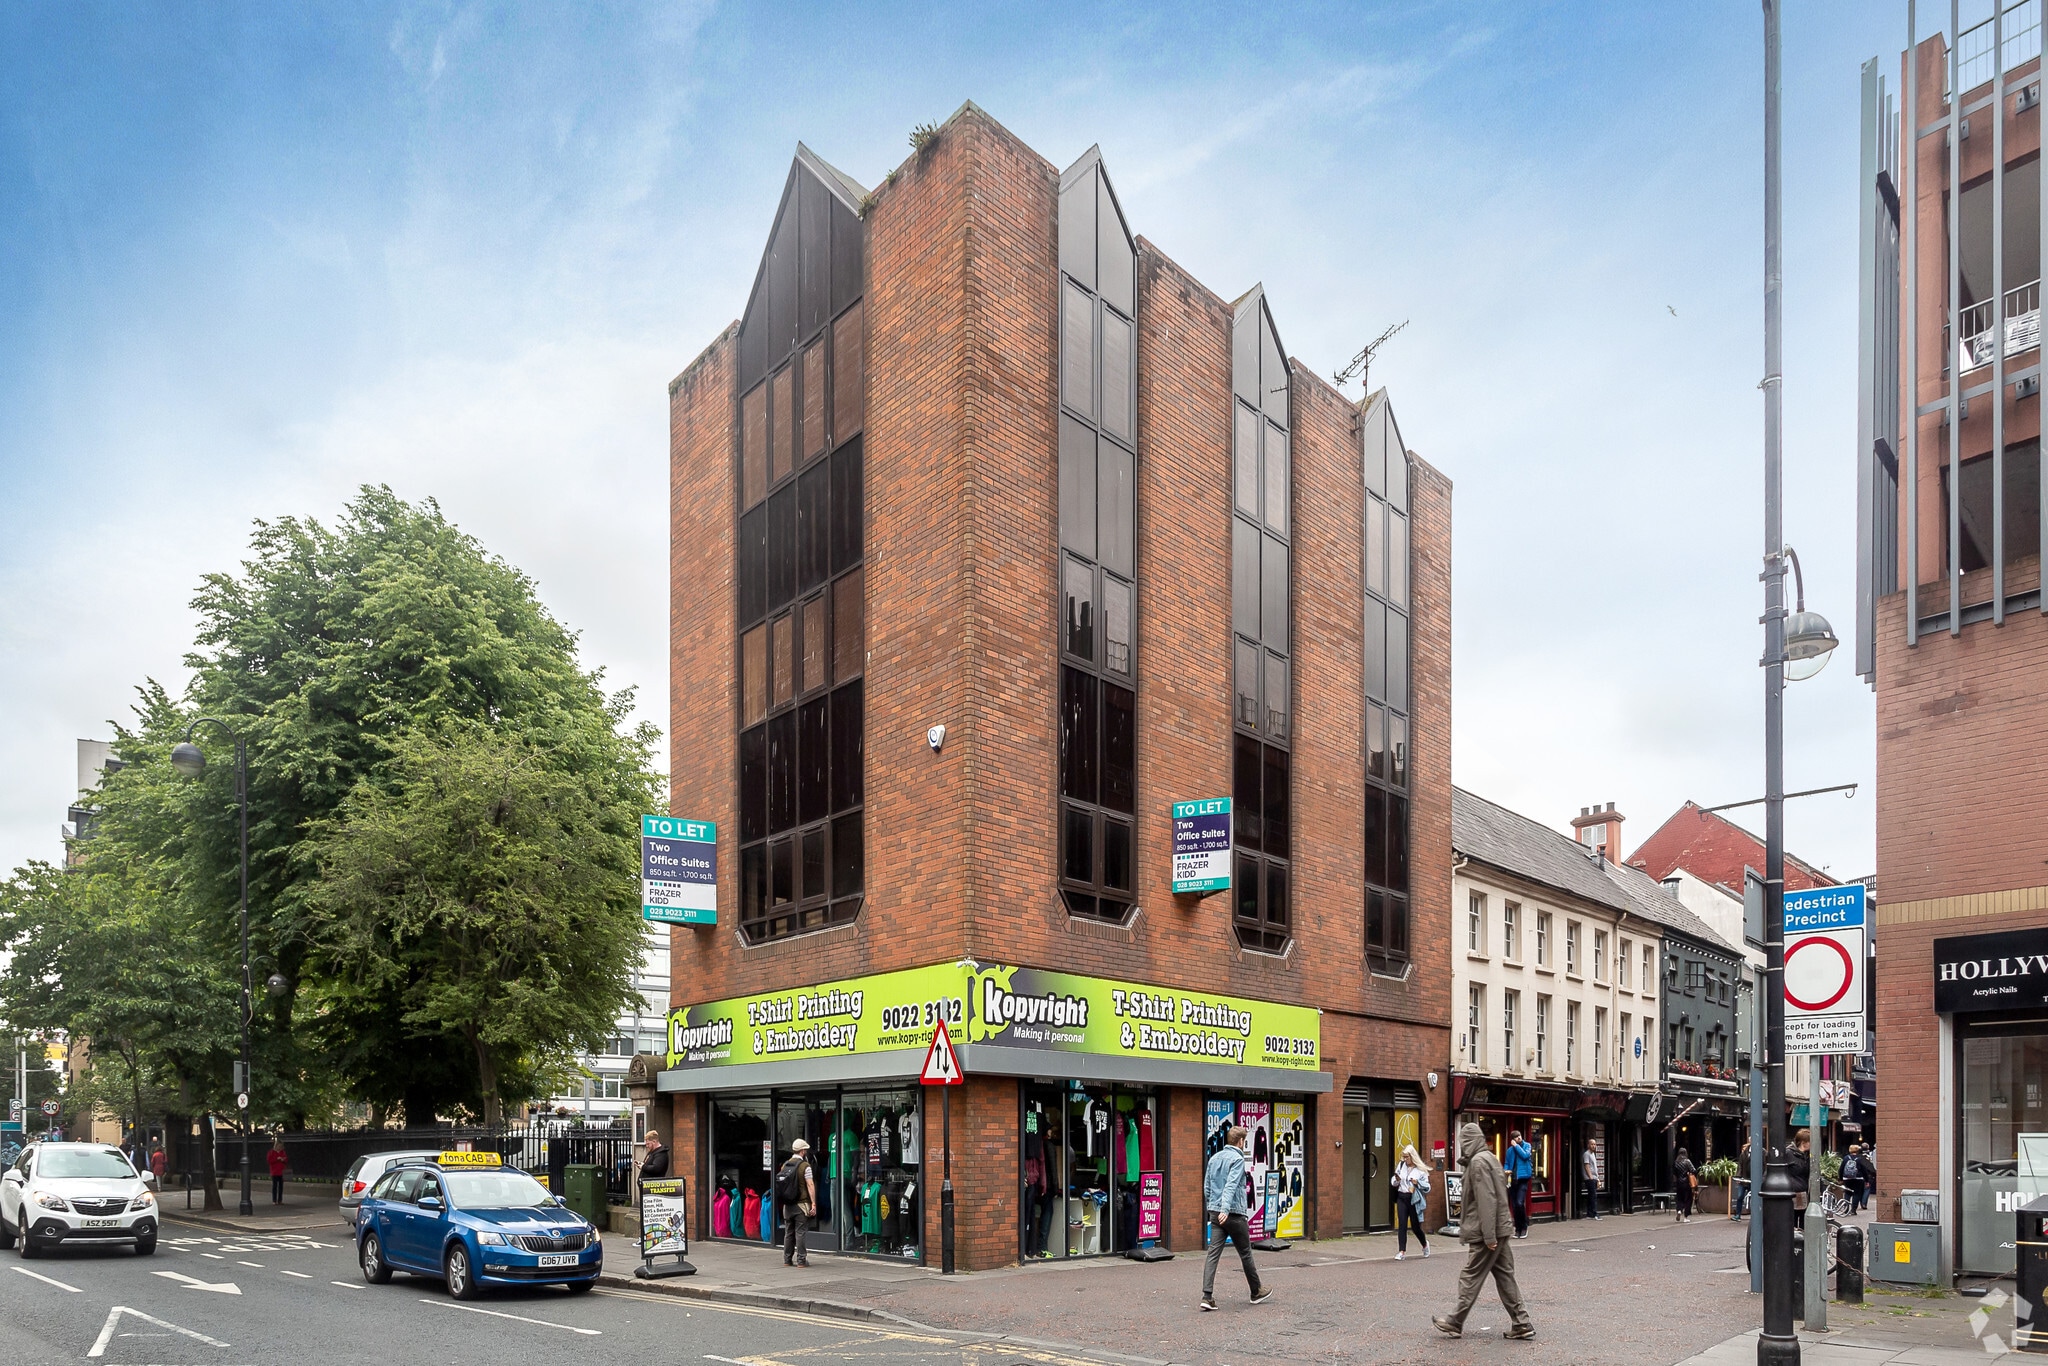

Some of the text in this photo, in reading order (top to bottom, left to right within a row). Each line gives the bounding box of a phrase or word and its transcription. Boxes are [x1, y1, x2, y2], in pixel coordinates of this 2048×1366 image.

[1177, 801, 1222, 816] TO LET
[648, 819, 706, 838] TO LET
[1177, 821, 1194, 830] Two
[1177, 829, 1225, 841] Office Suites
[649, 842, 670, 852] Two
[649, 854, 710, 868] Office Suites
[1177, 860, 1208, 870] FRAZER
[1177, 870, 1196, 878] KIDD
[649, 889, 681, 898] FRAZER
[649, 896, 669, 905] KIDD
[1784, 894, 1855, 912] edestrian
[1785, 908, 1846, 926] Precinct
[1973, 987, 1998, 996] Acrylic
[748, 988, 863, 1026] T-Shirt Printing
[1112, 990, 1250, 1036] T-Shirt Printing
[882, 1004, 920, 1030] 9022
[1785, 1022, 1804, 1031] cept
[753, 1022, 858, 1055] & Embroidery
[878, 1028, 962, 1046] www.kopy-rigom
[1013, 1027, 1084, 1043] Making it personal
[1796, 1031, 1839, 1040] 6pm-11am
[1120, 1022, 1245, 1062] & Embroidery
[1265, 1036, 1314, 1056] 9022 3132
[1822, 1041, 1858, 1049] vehicles
[688, 1048, 731, 1062] Making it personal
[1262, 1055, 1315, 1067] www.kopy-right.com
[1208, 1102, 1230, 1112] FFER #1
[1241, 1102, 1268, 1114] OFFER #2
[1277, 1104, 1291, 1114] OFFER
[1208, 1115, 1220, 1132] 99
[1240, 1115, 1257, 1132] £99
[1276, 1117, 1290, 1132] £99
[1143, 1188, 1160, 1197] Printing
[1142, 1200, 1159, 1210] While
[1996, 1191, 2048, 1212] HO
[1145, 1212, 1156, 1222] You
[1142, 1224, 1156, 1234] Wait
[542, 1256, 576, 1266] GD67 UVR
